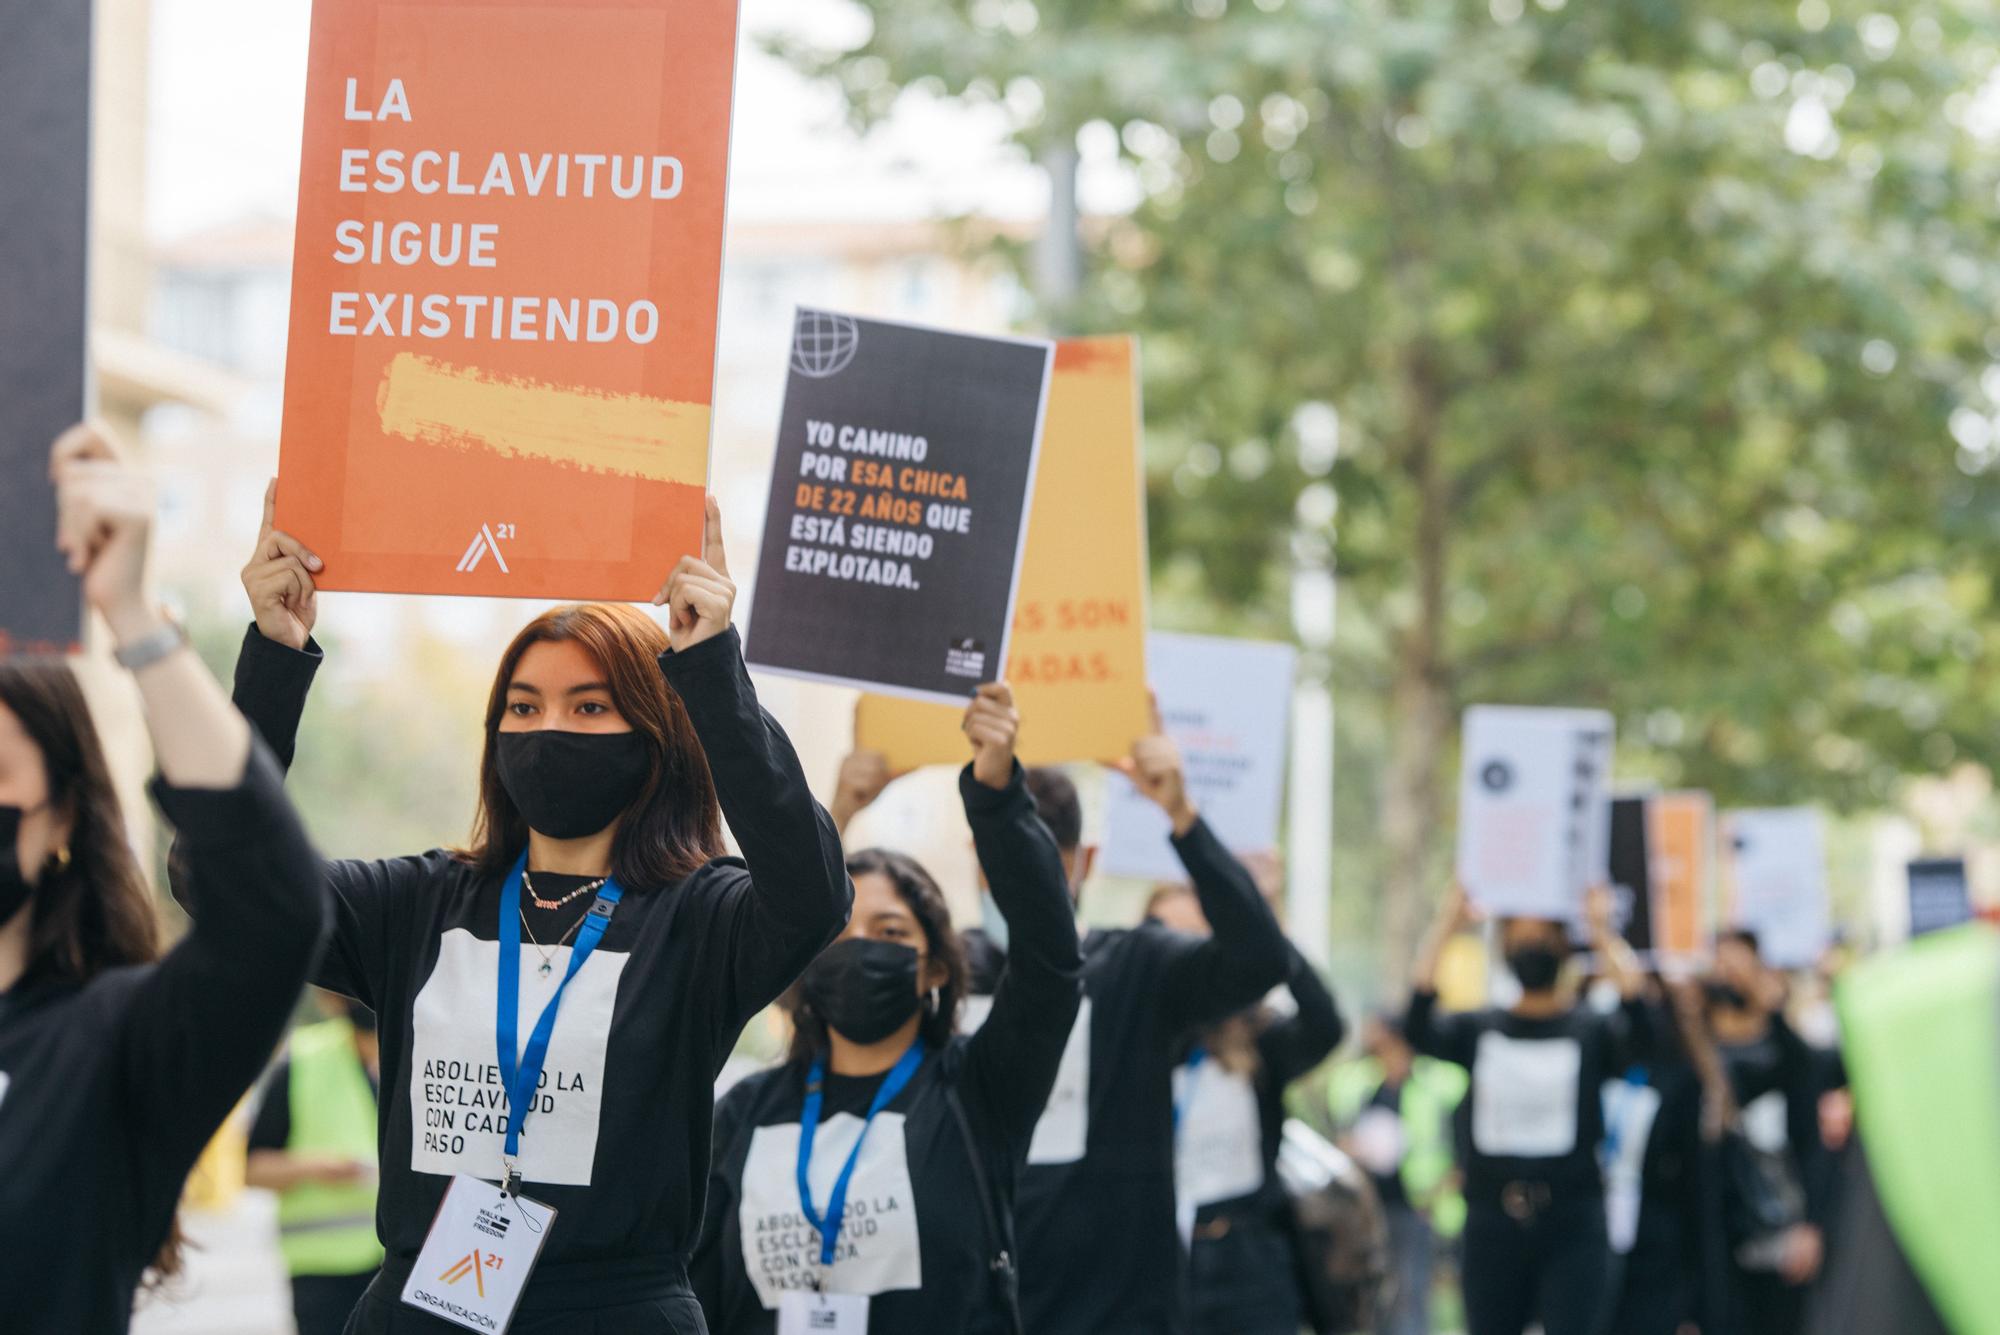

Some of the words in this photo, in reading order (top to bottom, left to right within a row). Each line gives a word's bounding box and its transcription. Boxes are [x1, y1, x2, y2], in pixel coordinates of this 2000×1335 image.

[344, 77, 412, 121] LA
[339, 149, 684, 200] ESCLAVITUD
[333, 220, 499, 267] SIGUE
[329, 292, 659, 344] EXISTIENDO
[806, 419, 835, 448] YO
[838, 425, 928, 462] CAMINO
[800, 451, 847, 482] POR
[851, 459, 893, 489] ESA
[900, 467, 968, 501] CHICA
[796, 483, 825, 511] DE
[828, 488, 857, 515] 22
[859, 491, 922, 525] AÑOS
[926, 503, 972, 534] QUE
[790, 513, 845, 546] ESTÁ
[850, 523, 933, 559] SIENDO
[785, 545, 920, 590] EXPLOTADA.
[1056, 598, 1130, 631] SON
[424, 1060, 547, 1089] ABOLIEO
[557, 1071, 584, 1092] LA
[425, 1083, 554, 1113] ESCLAVIUD
[426, 1108, 455, 1129] CON
[424, 1132, 464, 1154] PASO
[475, 1214, 490, 1225] FOR
[480, 1208, 498, 1221] WALK
[874, 1197, 898, 1213] LA
[473, 1222, 505, 1240] FREEDOM
[761, 1255, 799, 1273] CON
[807, 1243, 859, 1265] CDA
[414, 1289, 497, 1331] ORGANIZACIÓN
